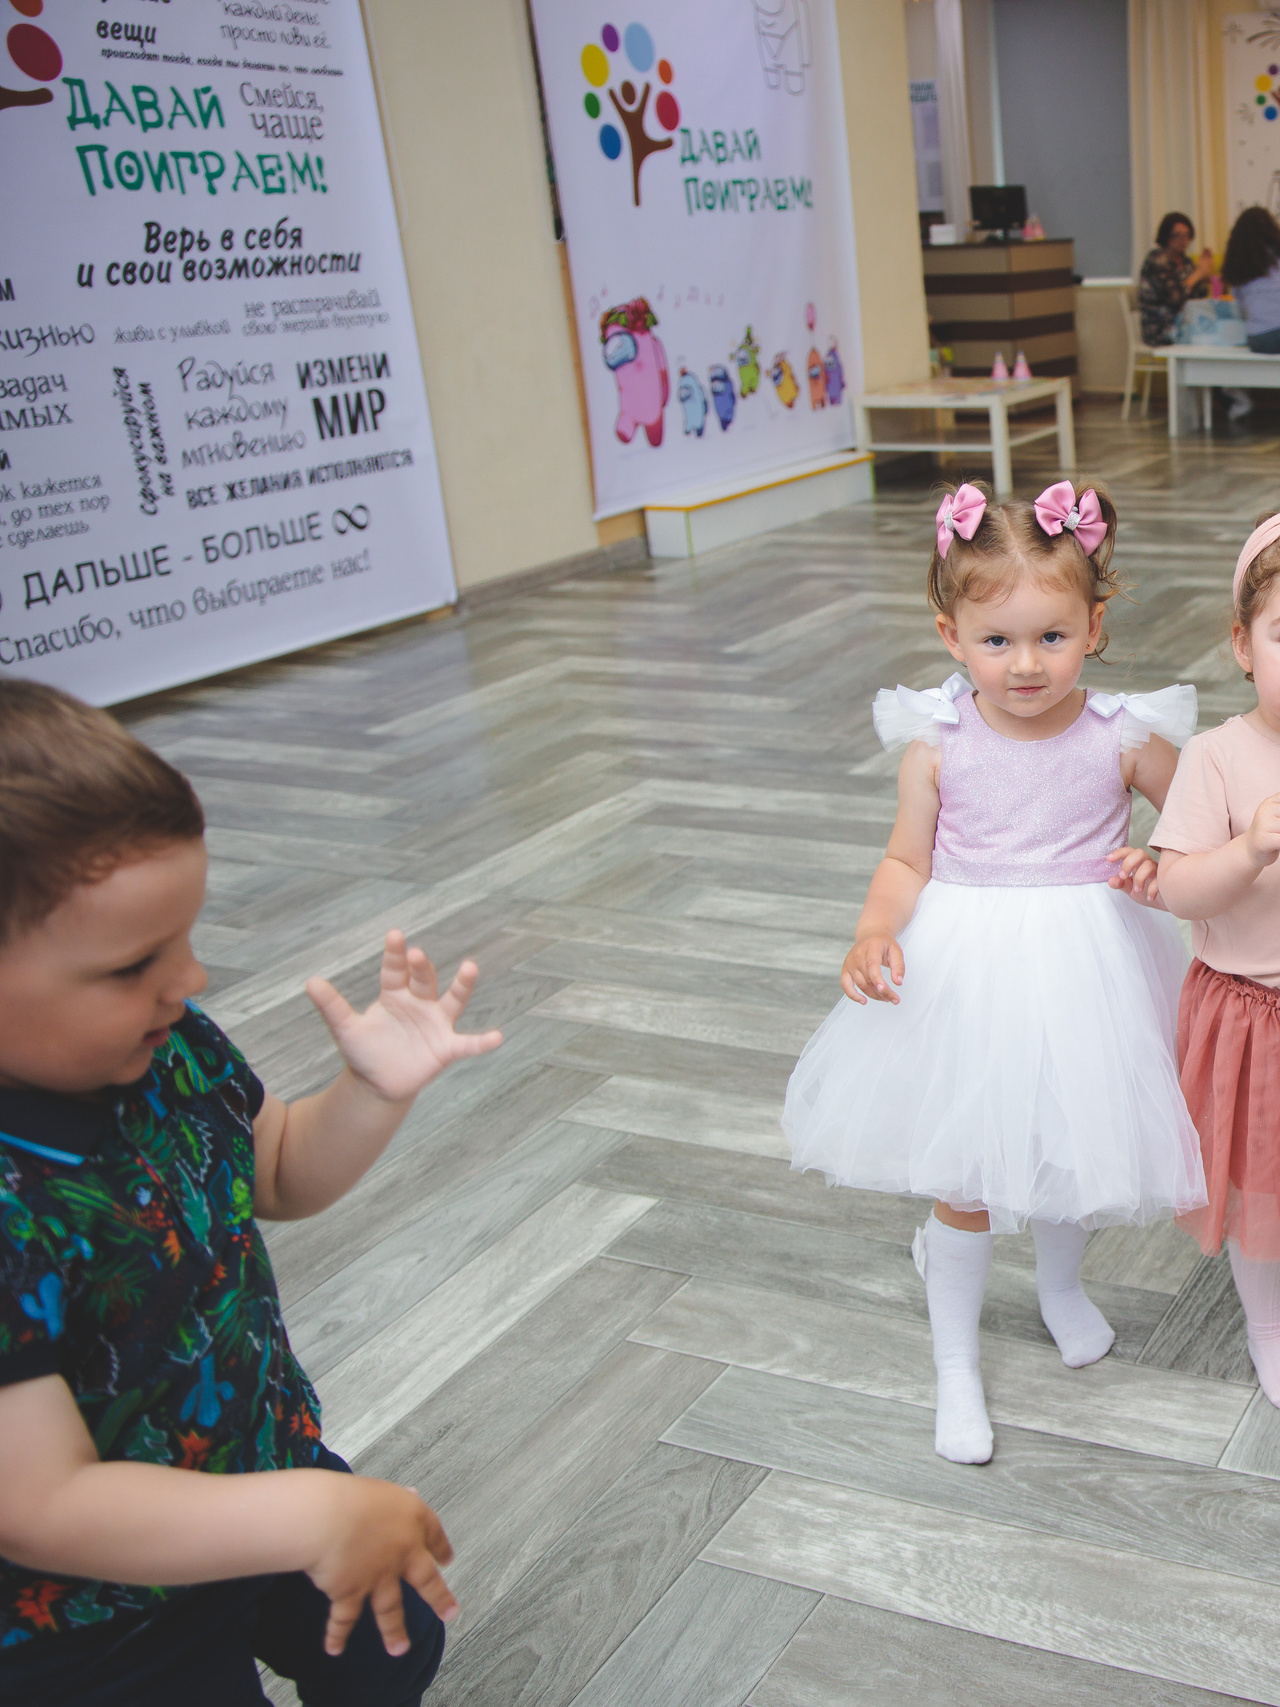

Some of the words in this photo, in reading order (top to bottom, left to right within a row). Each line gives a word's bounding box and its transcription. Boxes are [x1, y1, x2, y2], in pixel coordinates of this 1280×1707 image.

[96, 20, 157, 48] вещи
[61, 77, 226, 133] ДАВАЙ
[239, 81, 325, 114] Смейся,
[249, 112, 325, 144] чаще
[680, 128, 761, 166] ДАВАЙ
[75, 144, 328, 197] ПОИГРАЕМ!
[143, 221, 211, 260] Верь
[219, 228, 235, 251] в
[243, 216, 303, 250] себя
[76, 262, 95, 289] и
[105, 259, 173, 287] свои
[181, 251, 361, 283] возможности
[0, 322, 95, 358] изнью
[177, 355, 276, 398] Радуйся
[296, 352, 392, 390] ИЗМЕНИ
[185, 394, 289, 431] каждому
[312, 387, 387, 441] МИР
[181, 429, 307, 470] мгновению
[20, 474, 103, 500] кажется
[185, 484, 219, 510] ВСЕ
[223, 468, 304, 502] ЖЕЛАНИЯ
[10, 506, 33, 529] до
[37, 500, 75, 520] тех
[78, 494, 112, 513] пор
[7, 520, 90, 551] сделаешь
[22, 544, 173, 612] ДАЛЬШЕ
[201, 511, 323, 566] БОЛЬШЕ
[0, 612, 122, 665] Спасибо,
[128, 599, 187, 631] что
[192, 563, 325, 616] выбираете
[330, 547, 372, 579] нас!
